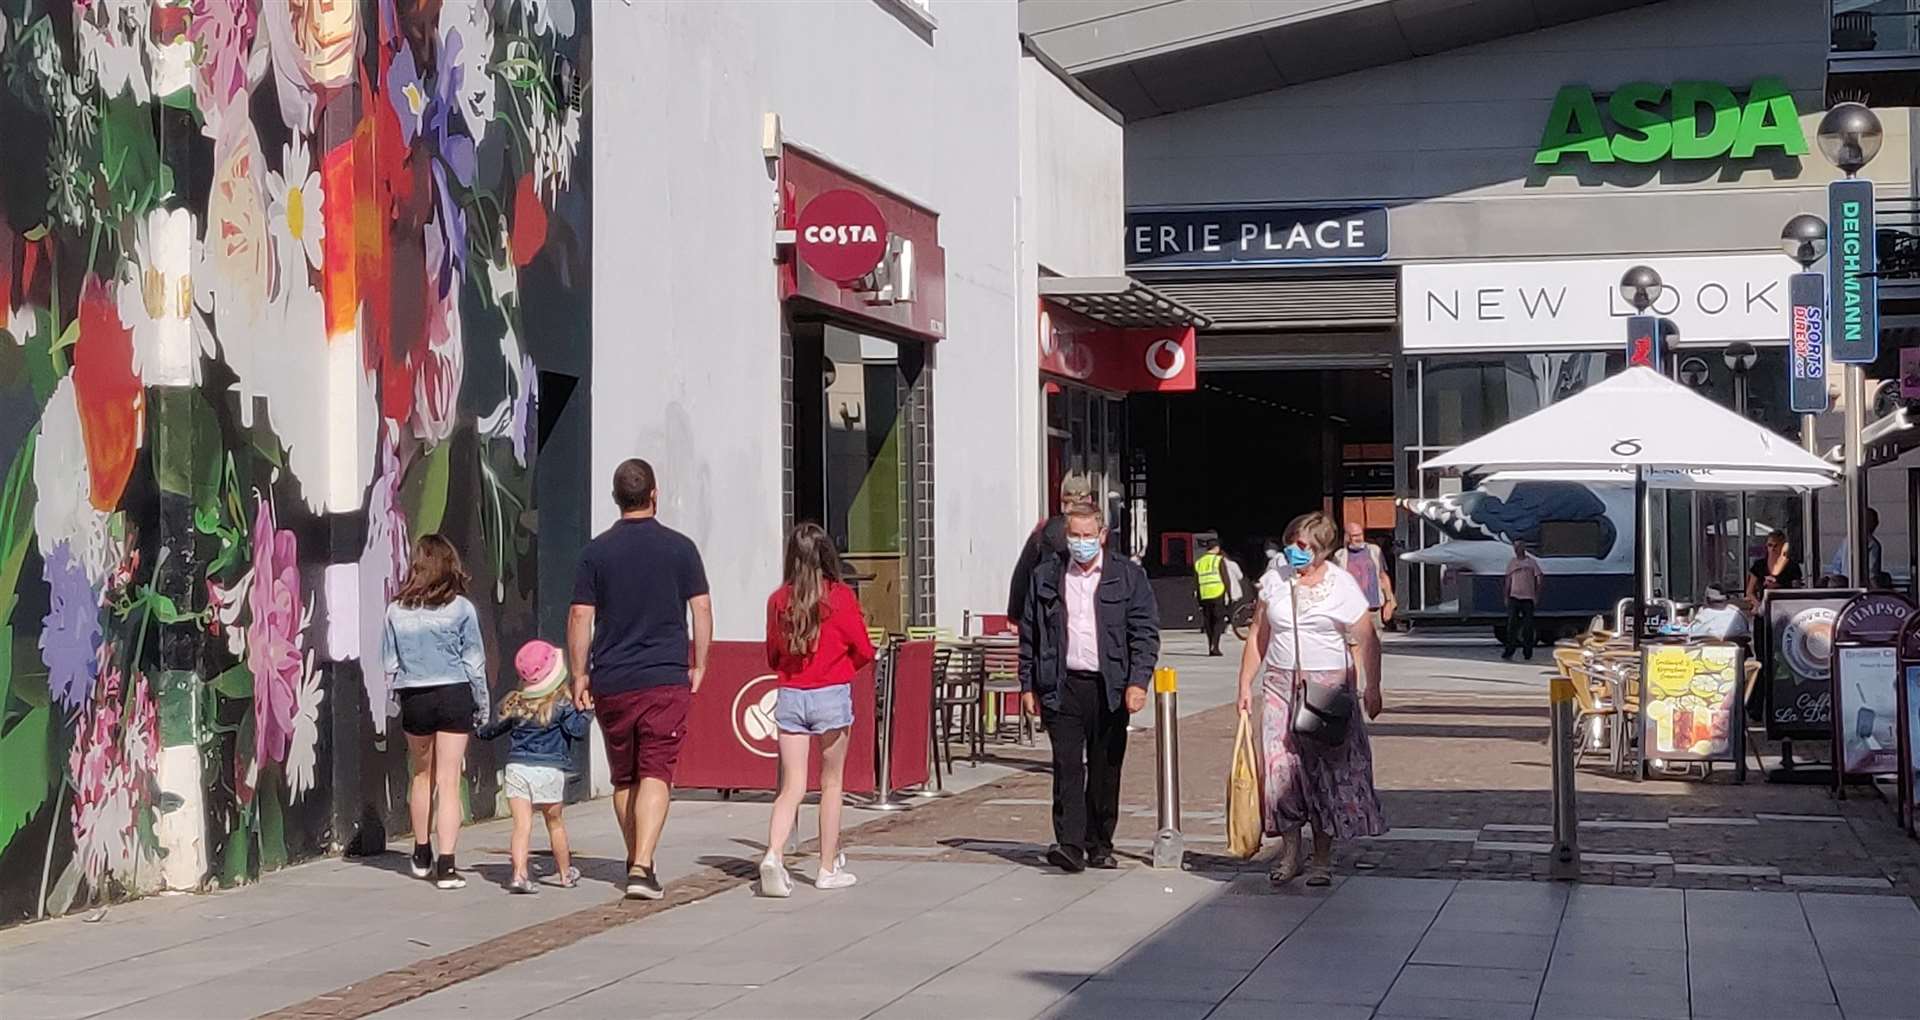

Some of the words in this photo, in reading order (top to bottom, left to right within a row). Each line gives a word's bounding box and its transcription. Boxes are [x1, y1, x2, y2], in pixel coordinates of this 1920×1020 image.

[1534, 75, 1810, 165] ASDA
[804, 225, 879, 245] COSTA
[1124, 224, 1221, 254] ERIE
[1241, 219, 1365, 251] PLACE
[1843, 201, 1861, 341] DEICHMANN
[1427, 286, 1567, 322] NEW
[1807, 306, 1822, 377] SPORTS
[1847, 602, 1906, 627] TIMPSO
